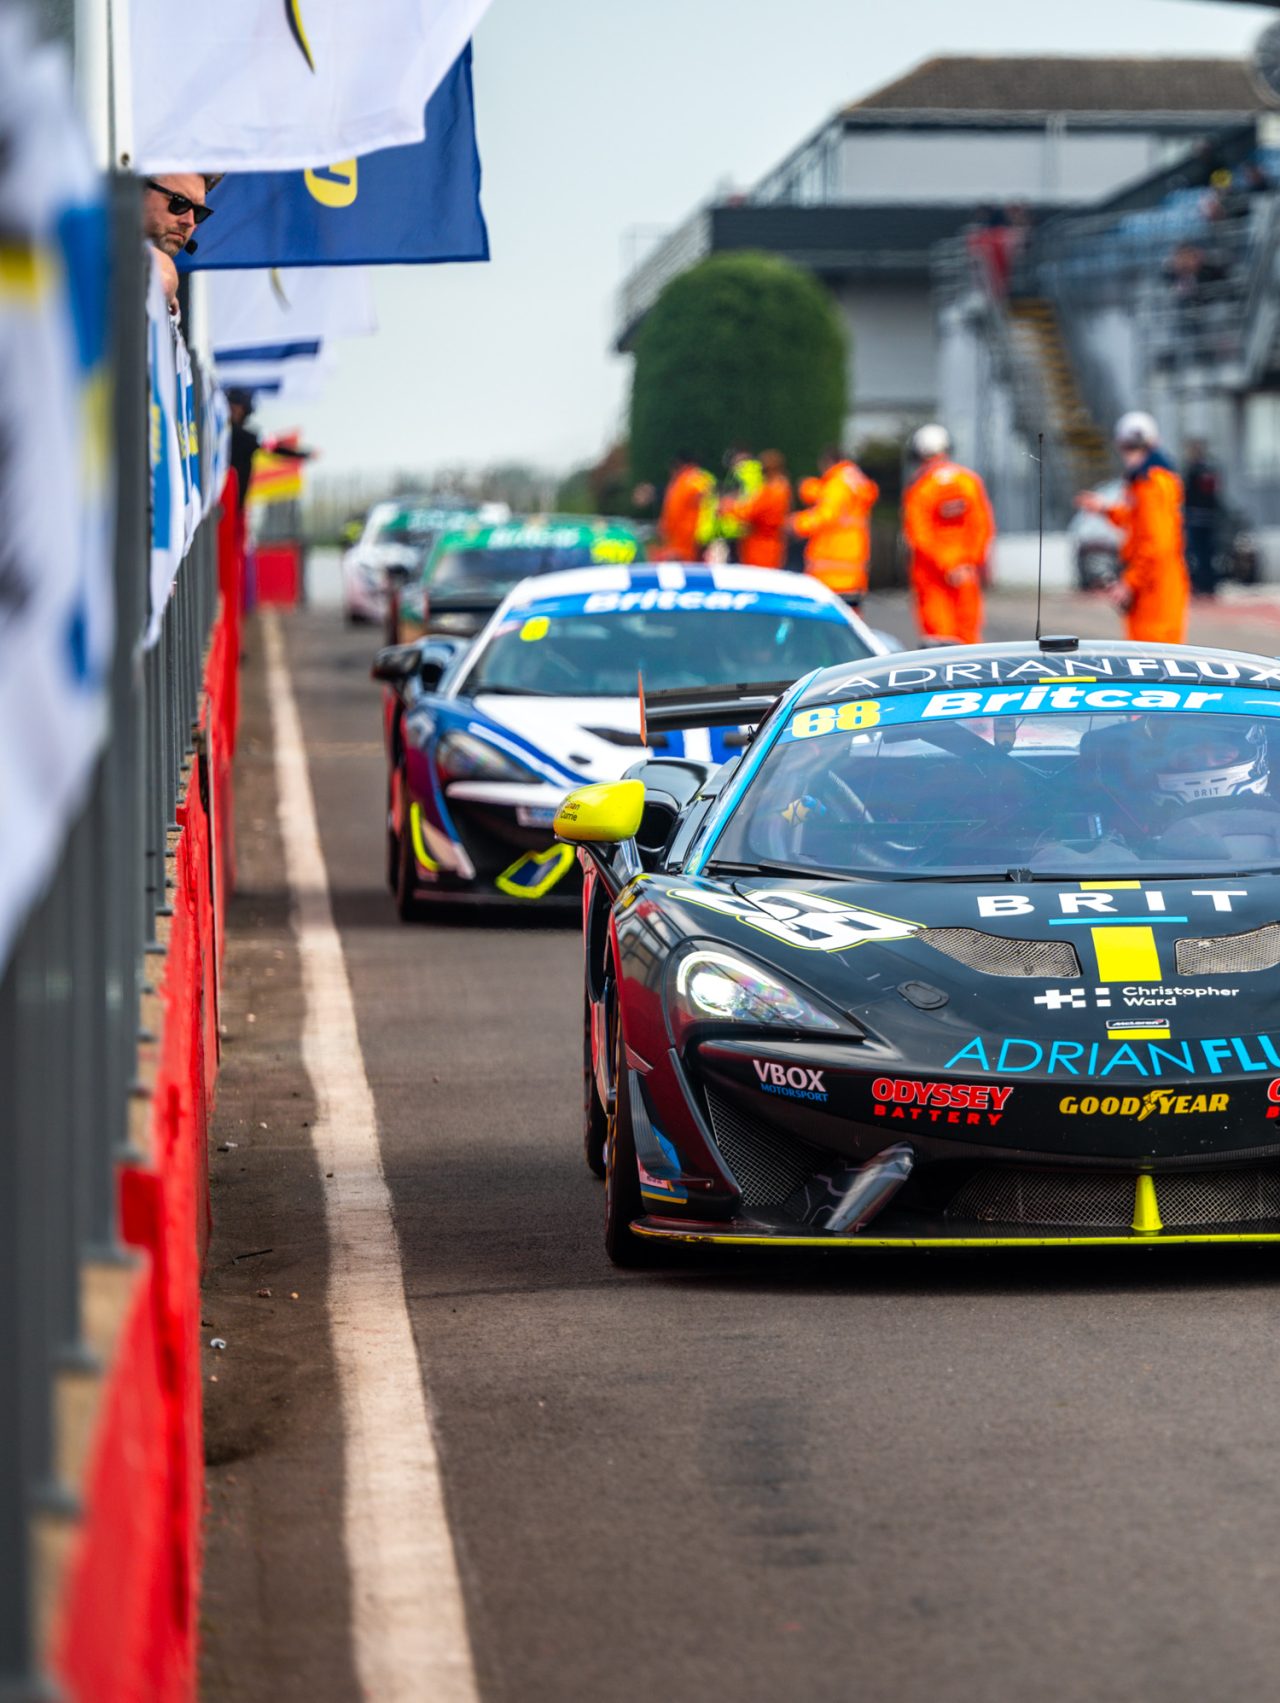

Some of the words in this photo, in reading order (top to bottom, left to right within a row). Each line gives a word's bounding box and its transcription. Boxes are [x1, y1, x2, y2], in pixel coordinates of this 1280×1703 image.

[583, 588, 759, 613] Britcar
[921, 686, 1224, 718] Britcar
[791, 700, 880, 738] 68
[1193, 787, 1220, 798] BRIT
[976, 890, 1248, 918] BRIT
[1122, 986, 1240, 998] Christopher
[1123, 996, 1177, 1007] Ward
[753, 1060, 826, 1092] VBOX
[761, 1083, 829, 1102] MOTORSPORT
[872, 1078, 1014, 1110] ODYSSEY
[873, 1105, 1002, 1126] BATTERY
